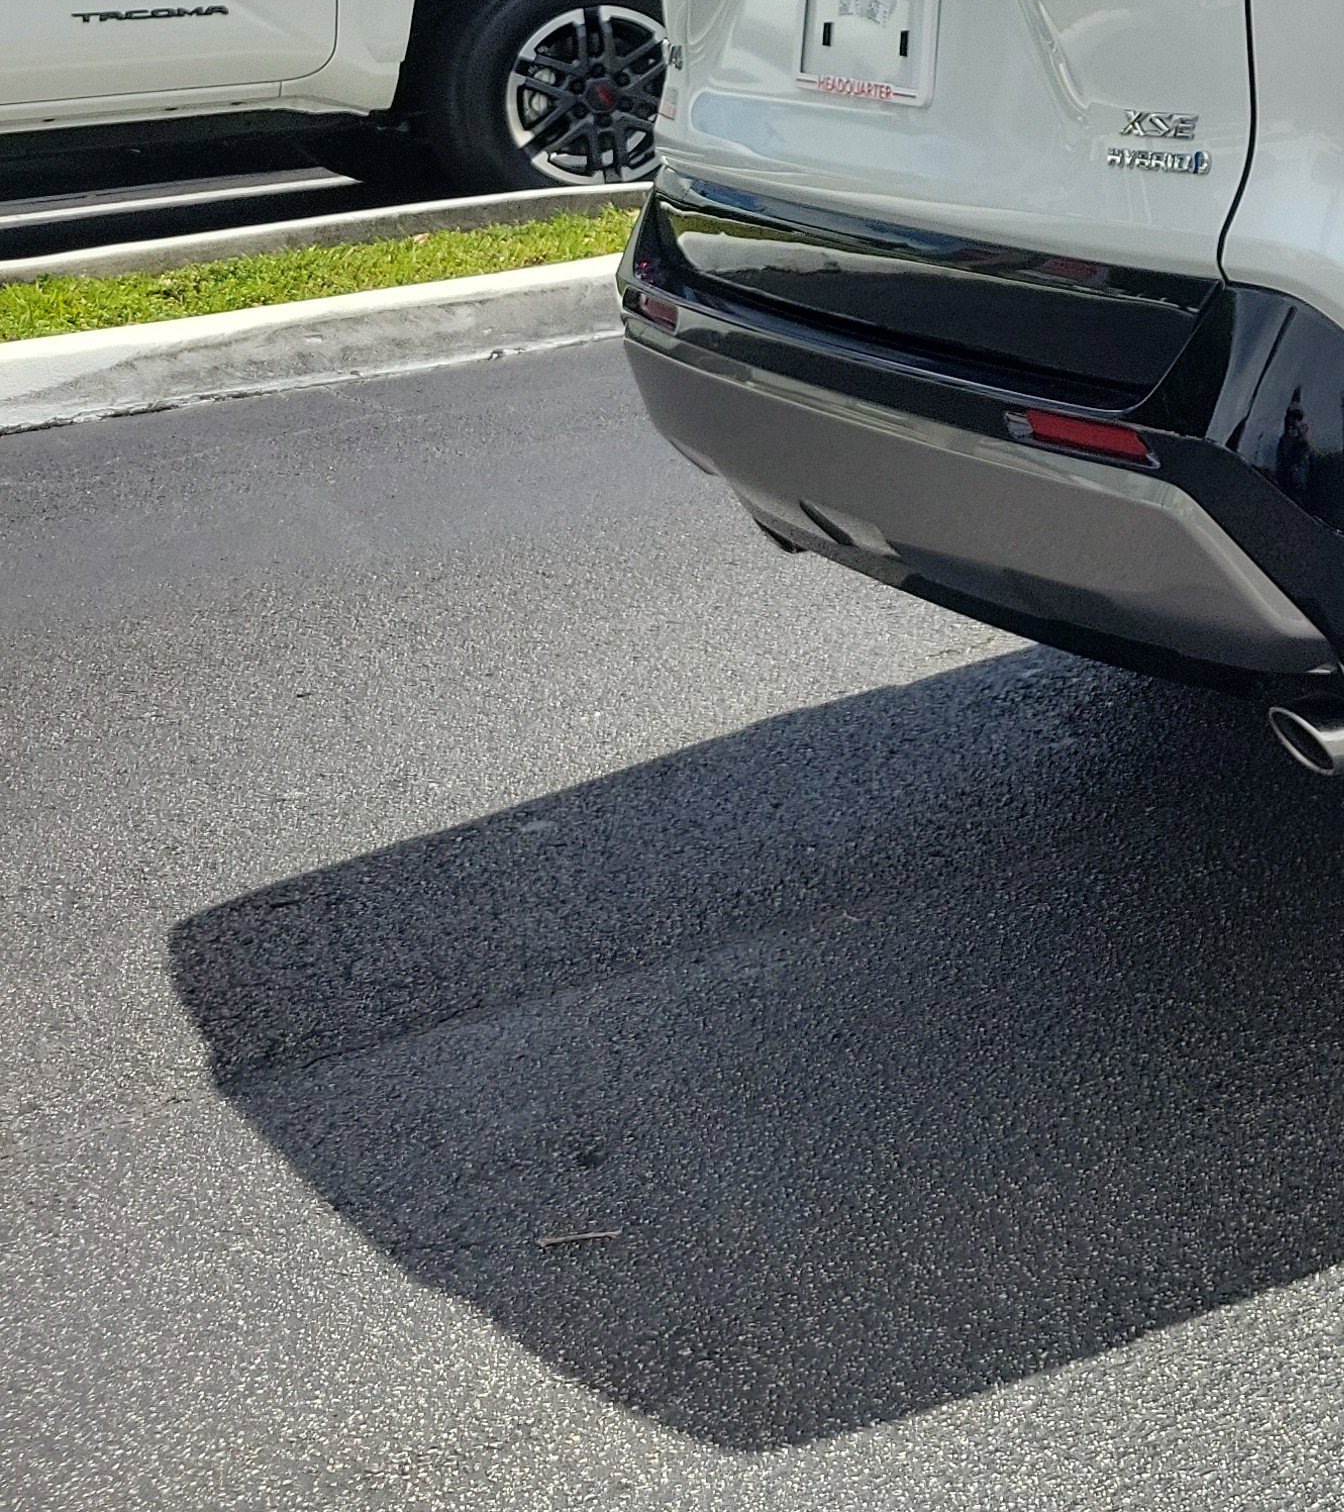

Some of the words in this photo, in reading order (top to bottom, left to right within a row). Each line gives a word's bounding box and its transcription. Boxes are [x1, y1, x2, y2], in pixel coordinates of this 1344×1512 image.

[71, 4, 230, 24] TACOMA
[817, 76, 893, 100] HEADQUARTER
[1119, 108, 1199, 140] XSE
[1106, 147, 1192, 173] HYBRID
